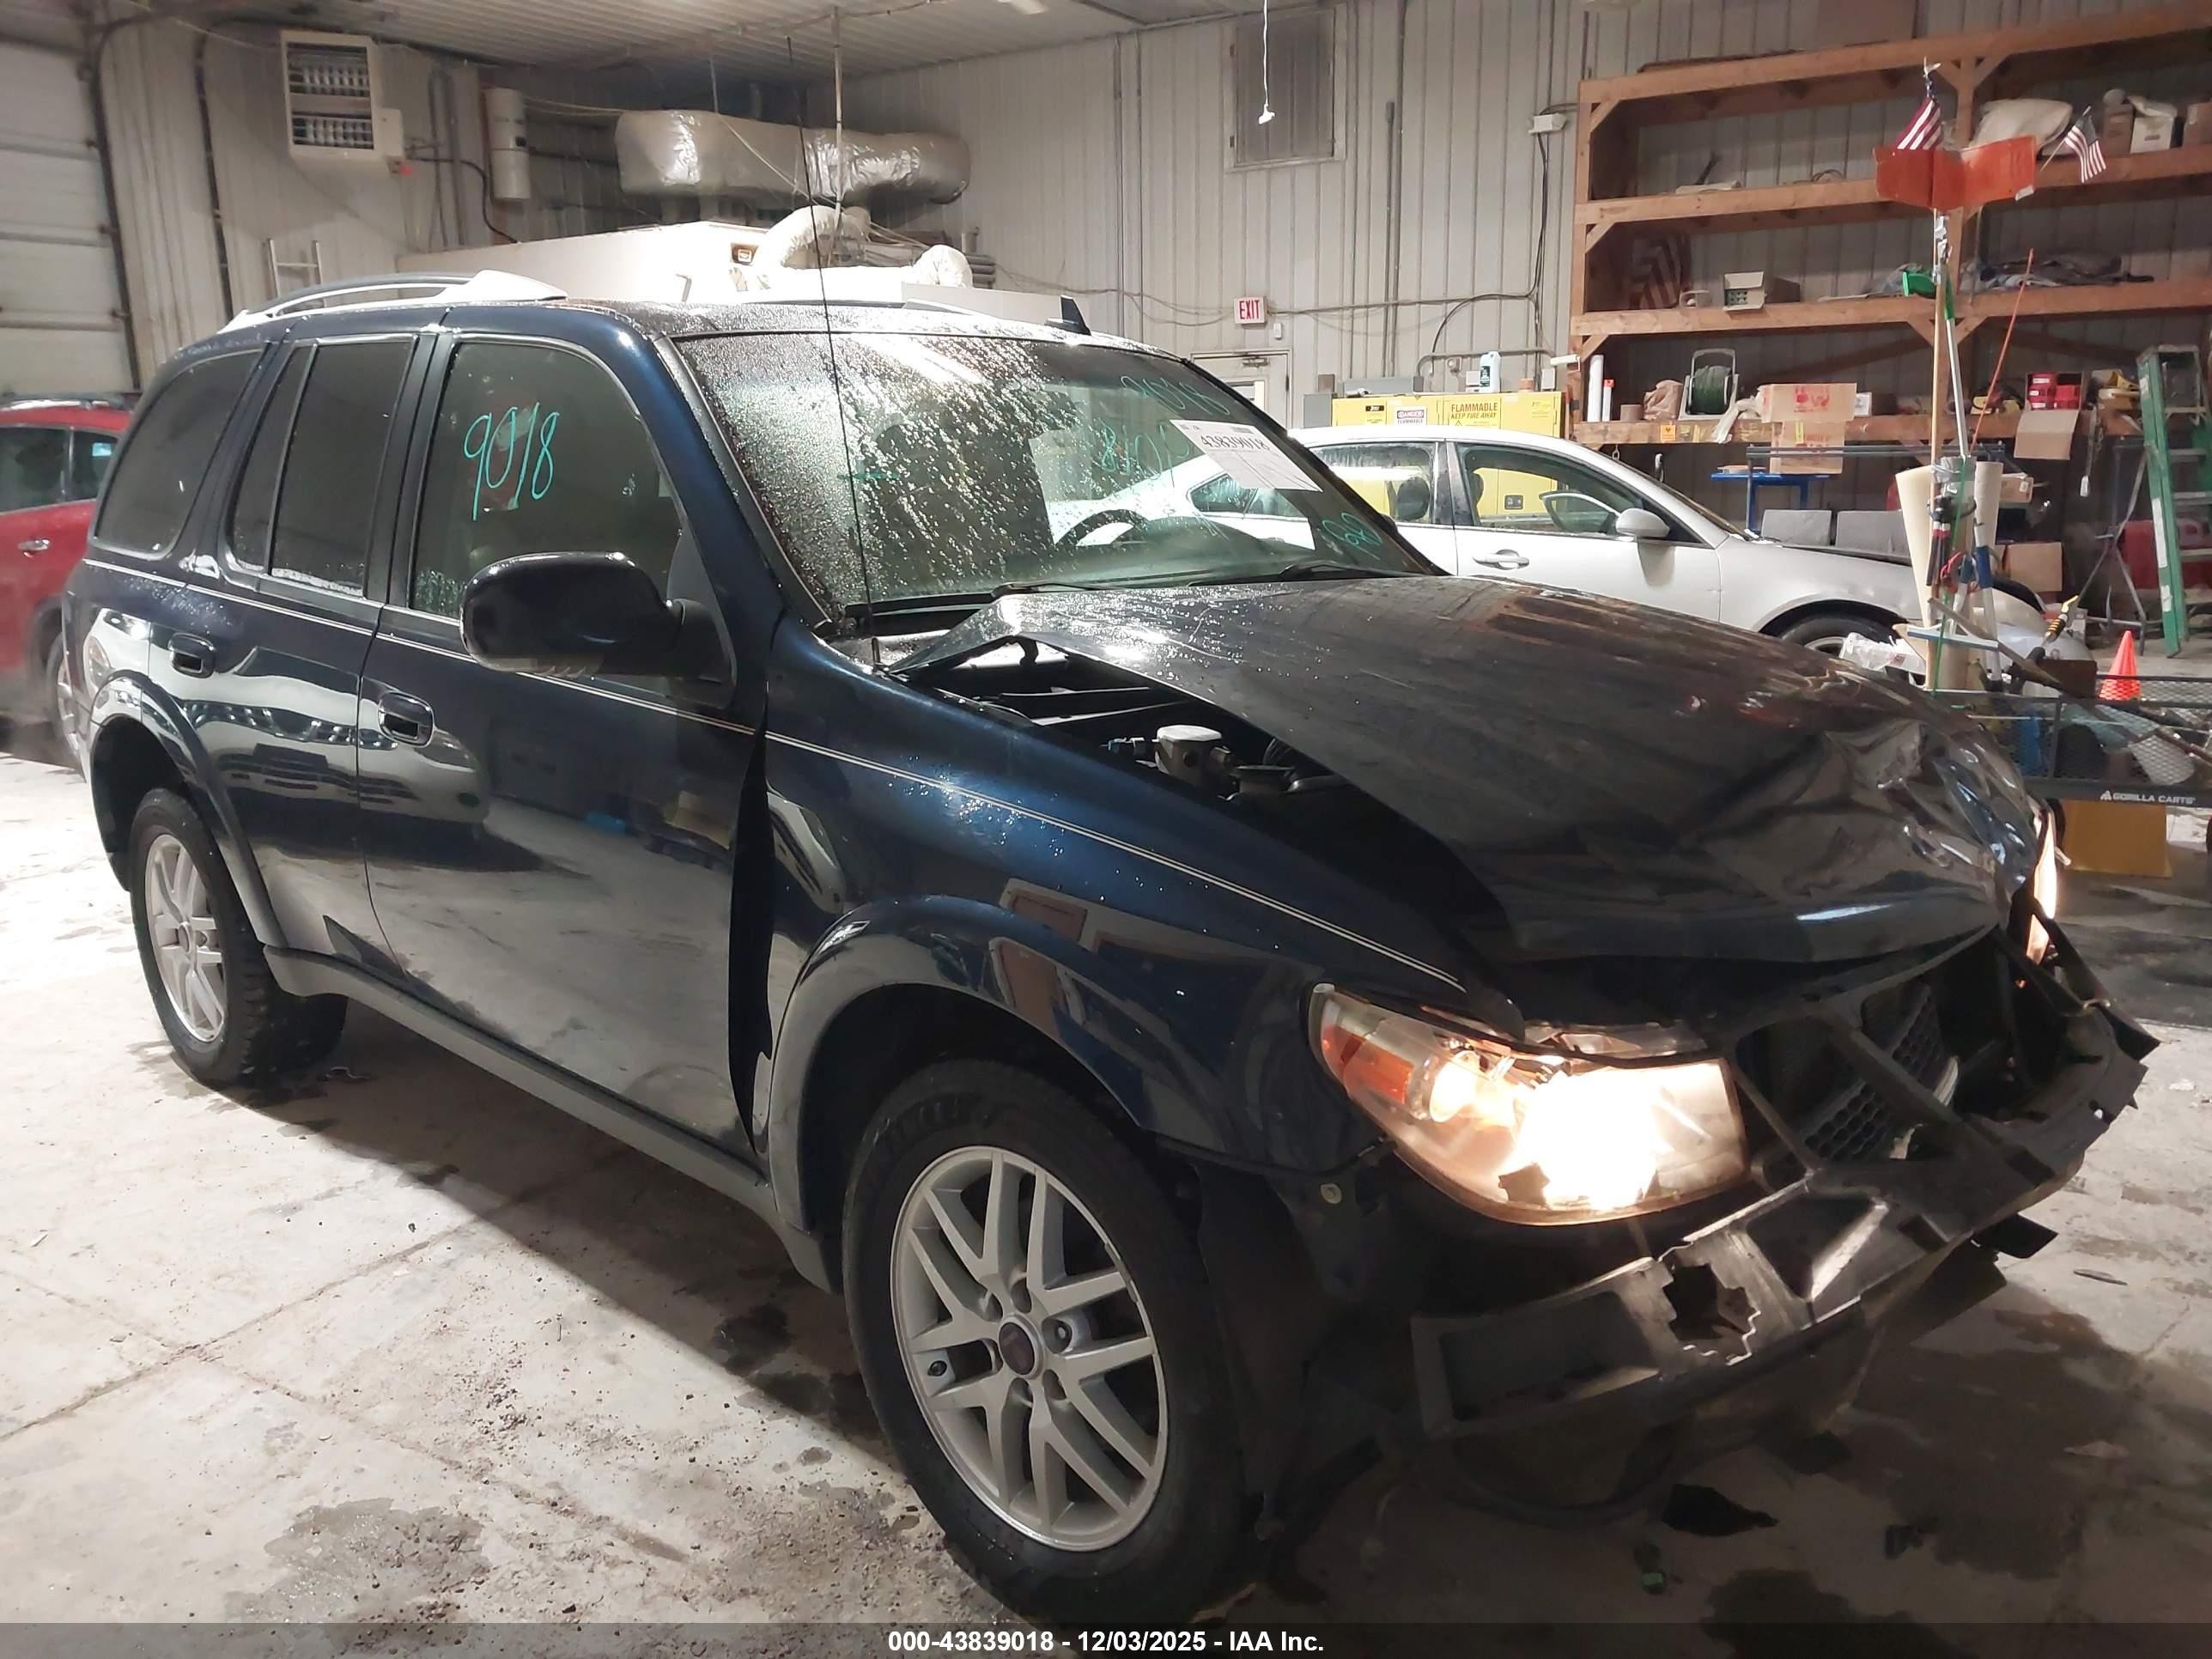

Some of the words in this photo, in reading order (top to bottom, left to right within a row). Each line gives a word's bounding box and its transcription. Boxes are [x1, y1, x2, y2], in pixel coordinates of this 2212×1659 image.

[1239, 300, 1260, 319] EXIT
[1121, 375, 1231, 417] 9018
[1451, 402, 1498, 412] FLAMMABLE
[1200, 435, 1270, 451] 43839018
[464, 402, 559, 520] 9018
[2112, 793, 2155, 802] GORILLA
[2158, 795, 2194, 805] CARTS
